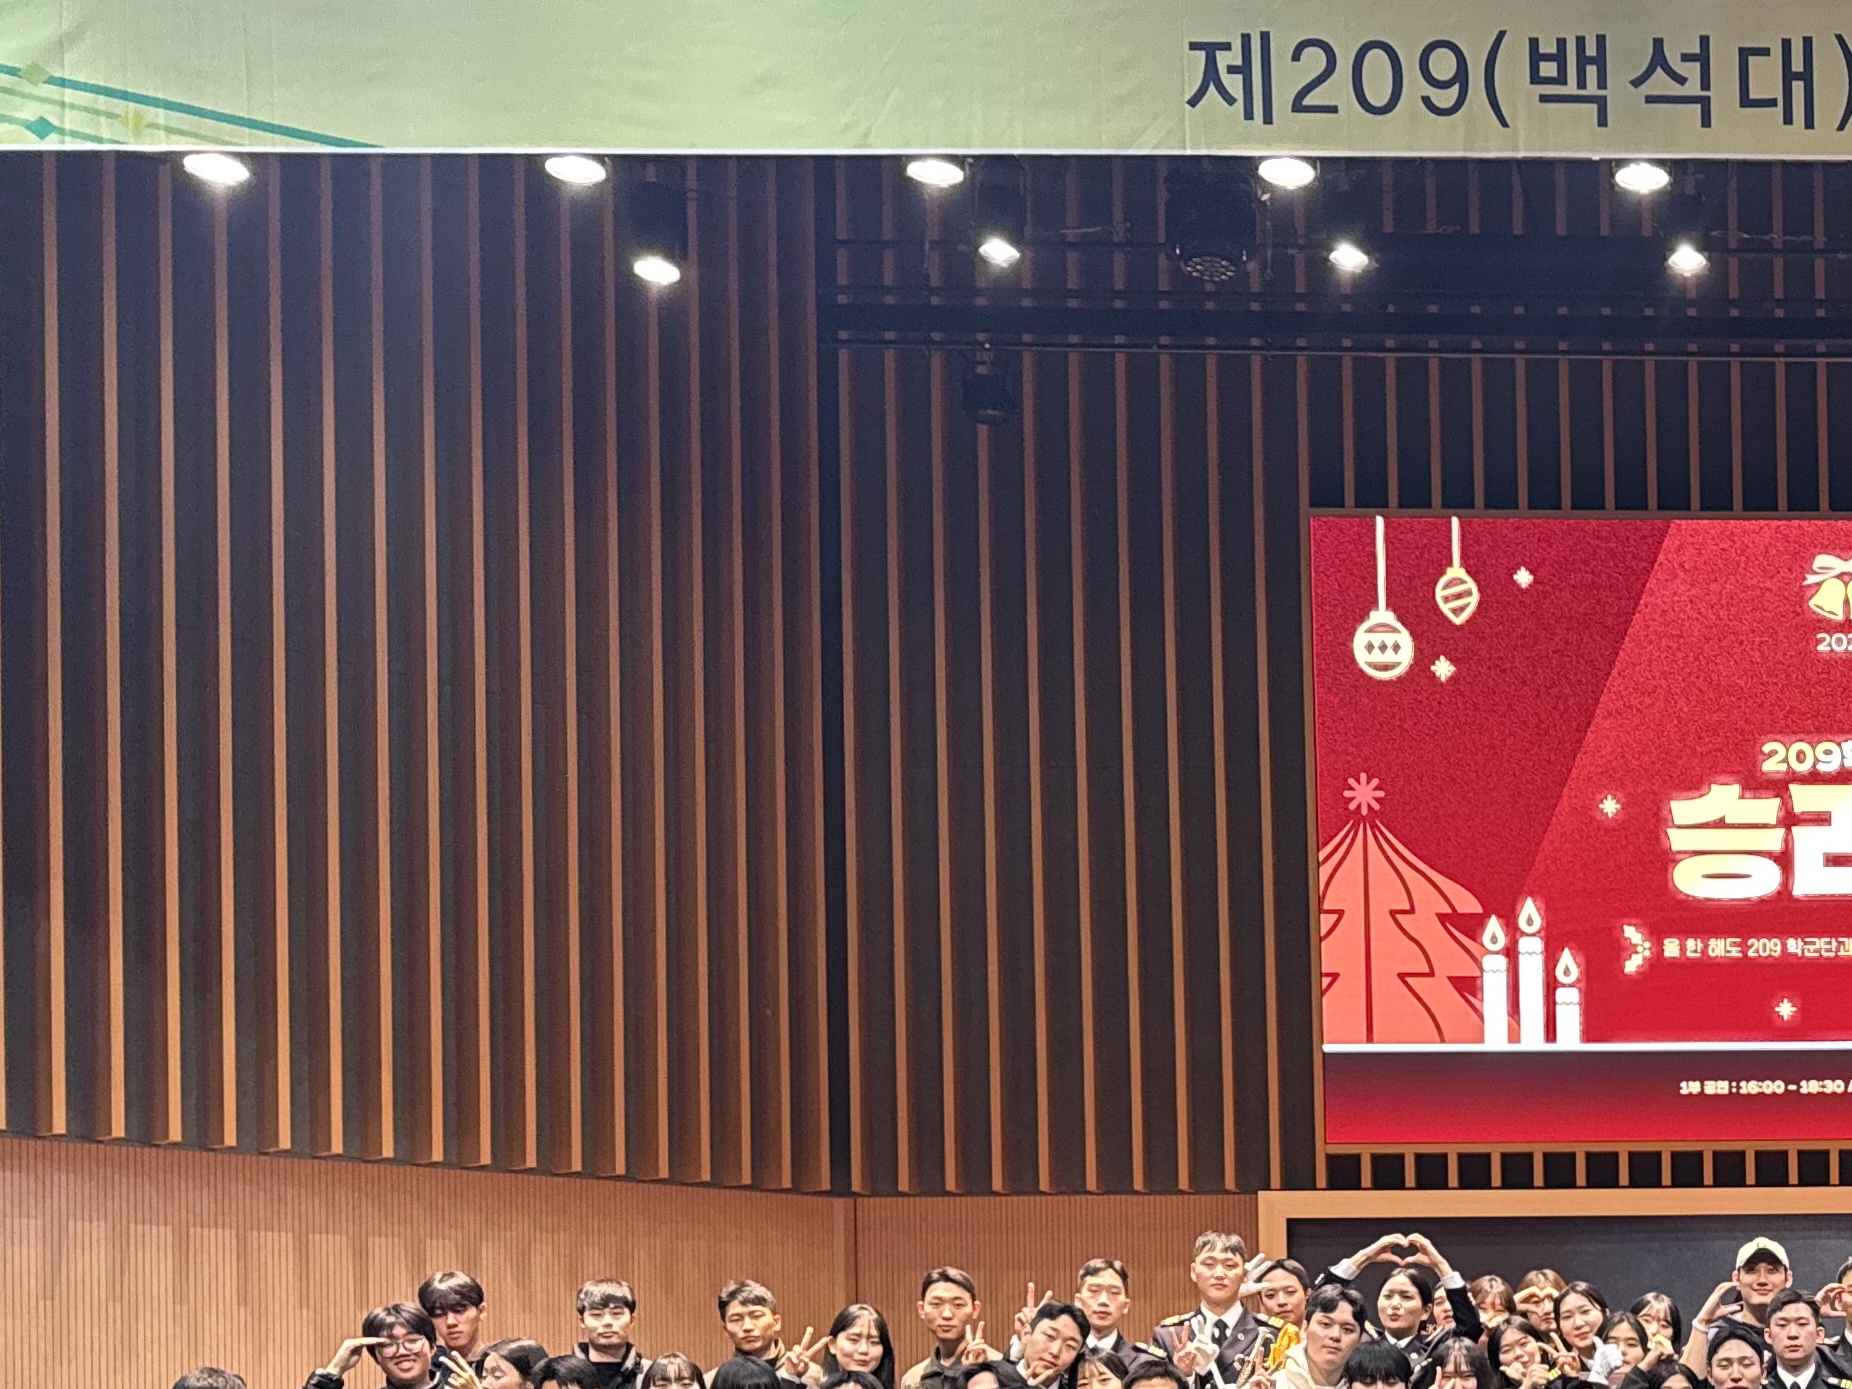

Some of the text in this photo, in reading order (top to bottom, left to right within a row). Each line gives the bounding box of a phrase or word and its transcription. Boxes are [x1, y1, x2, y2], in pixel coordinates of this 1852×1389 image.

[1662, 938, 1682, 958] 올
[1685, 938, 1704, 958] 한
[1708, 937, 1743, 958] 해도
[1747, 937, 1782, 958] 209
[1739, 1080, 1786, 1095] 16:00
[1799, 1079, 1846, 1095] 18:30
